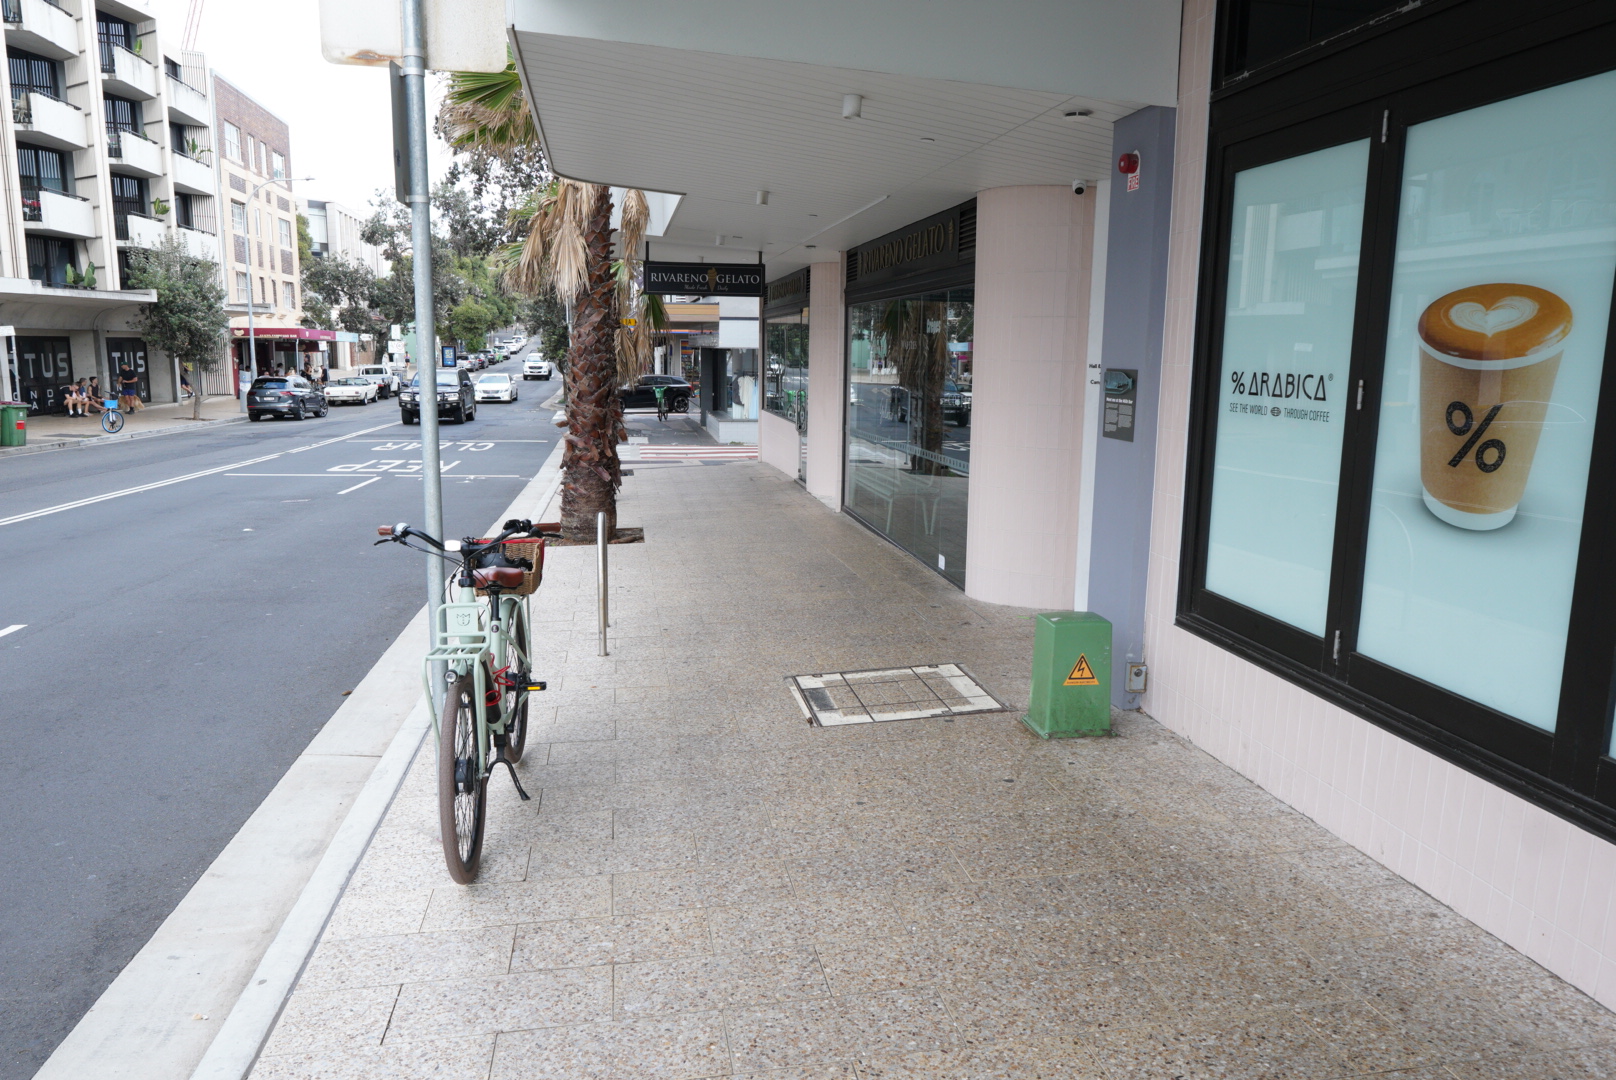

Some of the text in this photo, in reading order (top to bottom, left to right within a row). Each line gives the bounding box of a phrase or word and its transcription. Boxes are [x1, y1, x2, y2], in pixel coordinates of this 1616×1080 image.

[863, 223, 945, 275] RIVARENO GELATO
[650, 272, 760, 285] RIVARENO GELATO
[1229, 402, 1330, 423] SEE THE WORLD THROUGH COFFEE
